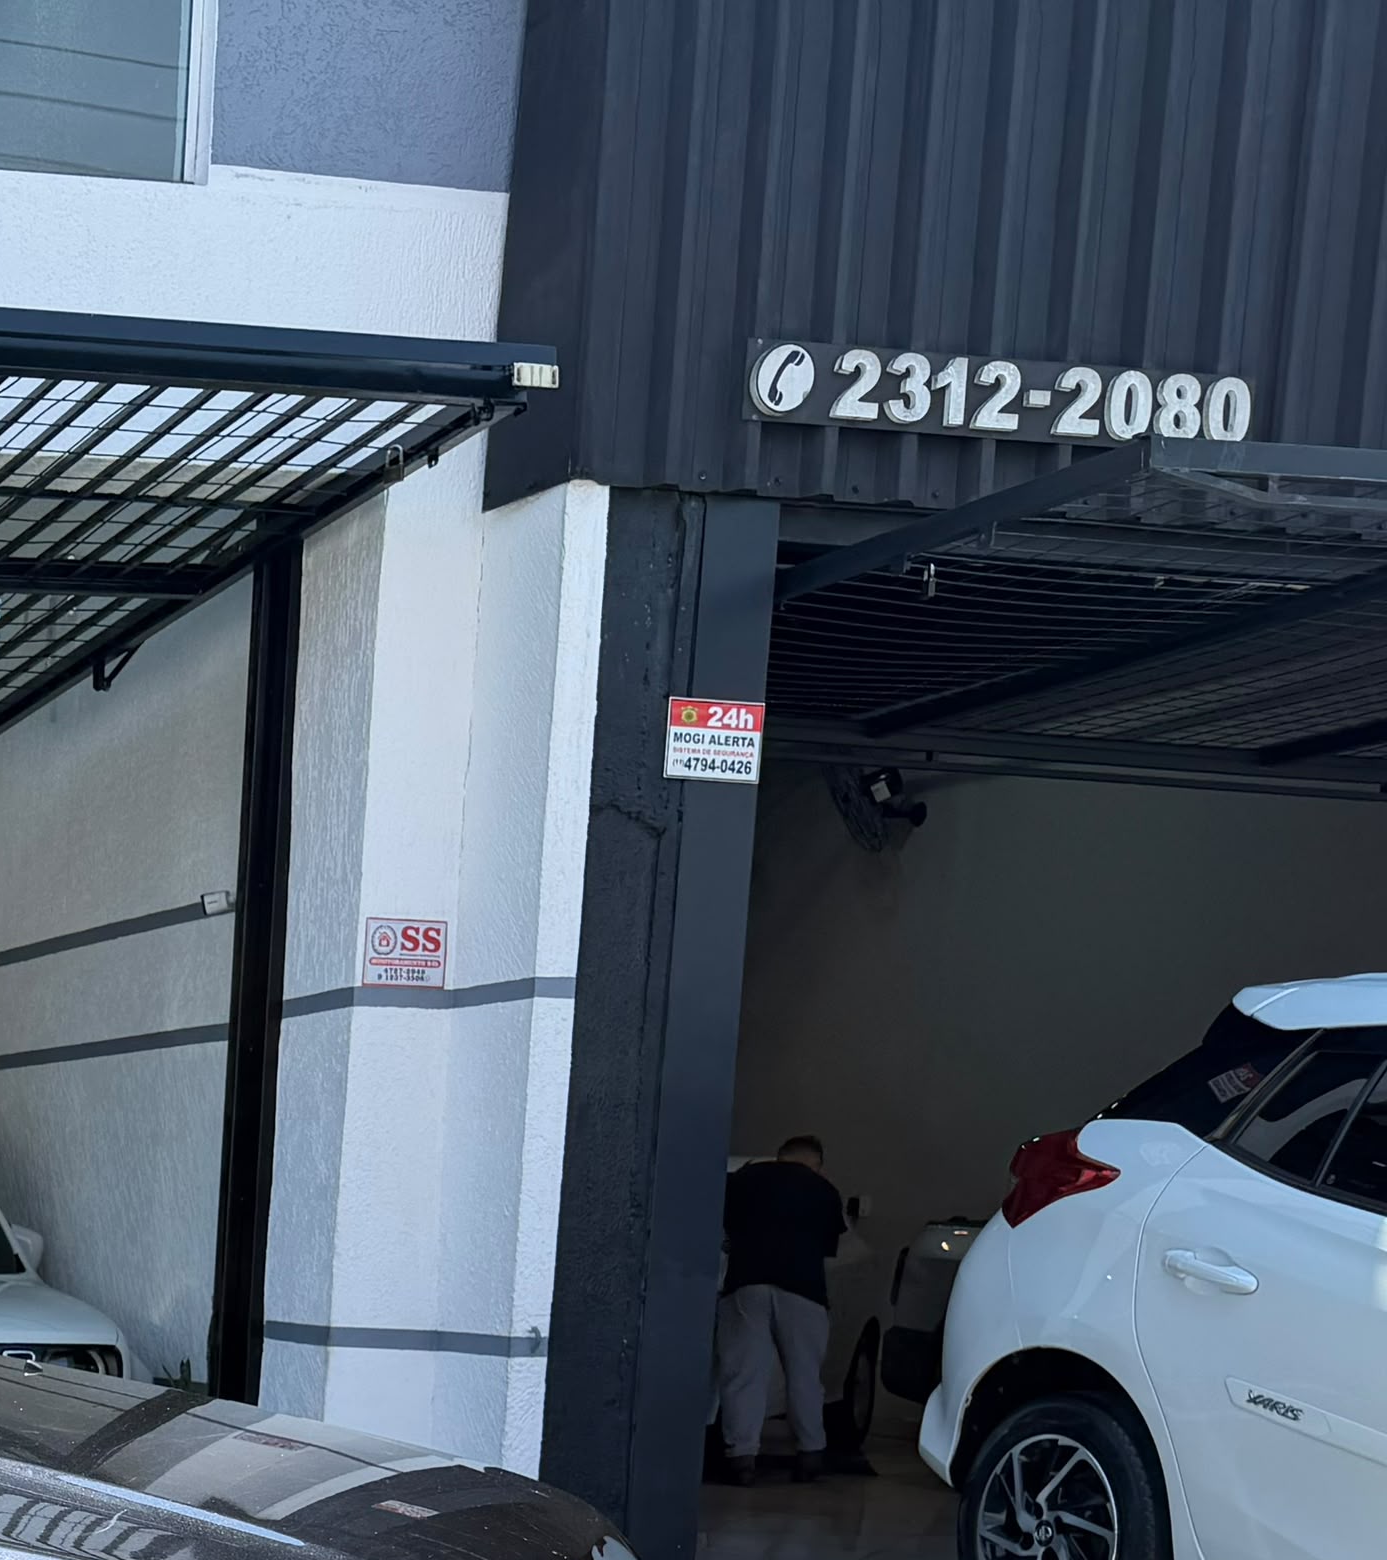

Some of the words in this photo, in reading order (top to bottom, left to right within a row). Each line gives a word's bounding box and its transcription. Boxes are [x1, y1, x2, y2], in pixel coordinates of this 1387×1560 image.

[829, 349, 1252, 442] 2312-2080
[707, 706, 754, 729] 24h
[673, 732, 705, 745] MOGI
[708, 734, 755, 748] ALERTA
[673, 746, 701, 755] SISTEMA
[702, 748, 712, 756] DE
[400, 926, 441, 953] SS
[1246, 1389, 1305, 1422] YARIS
